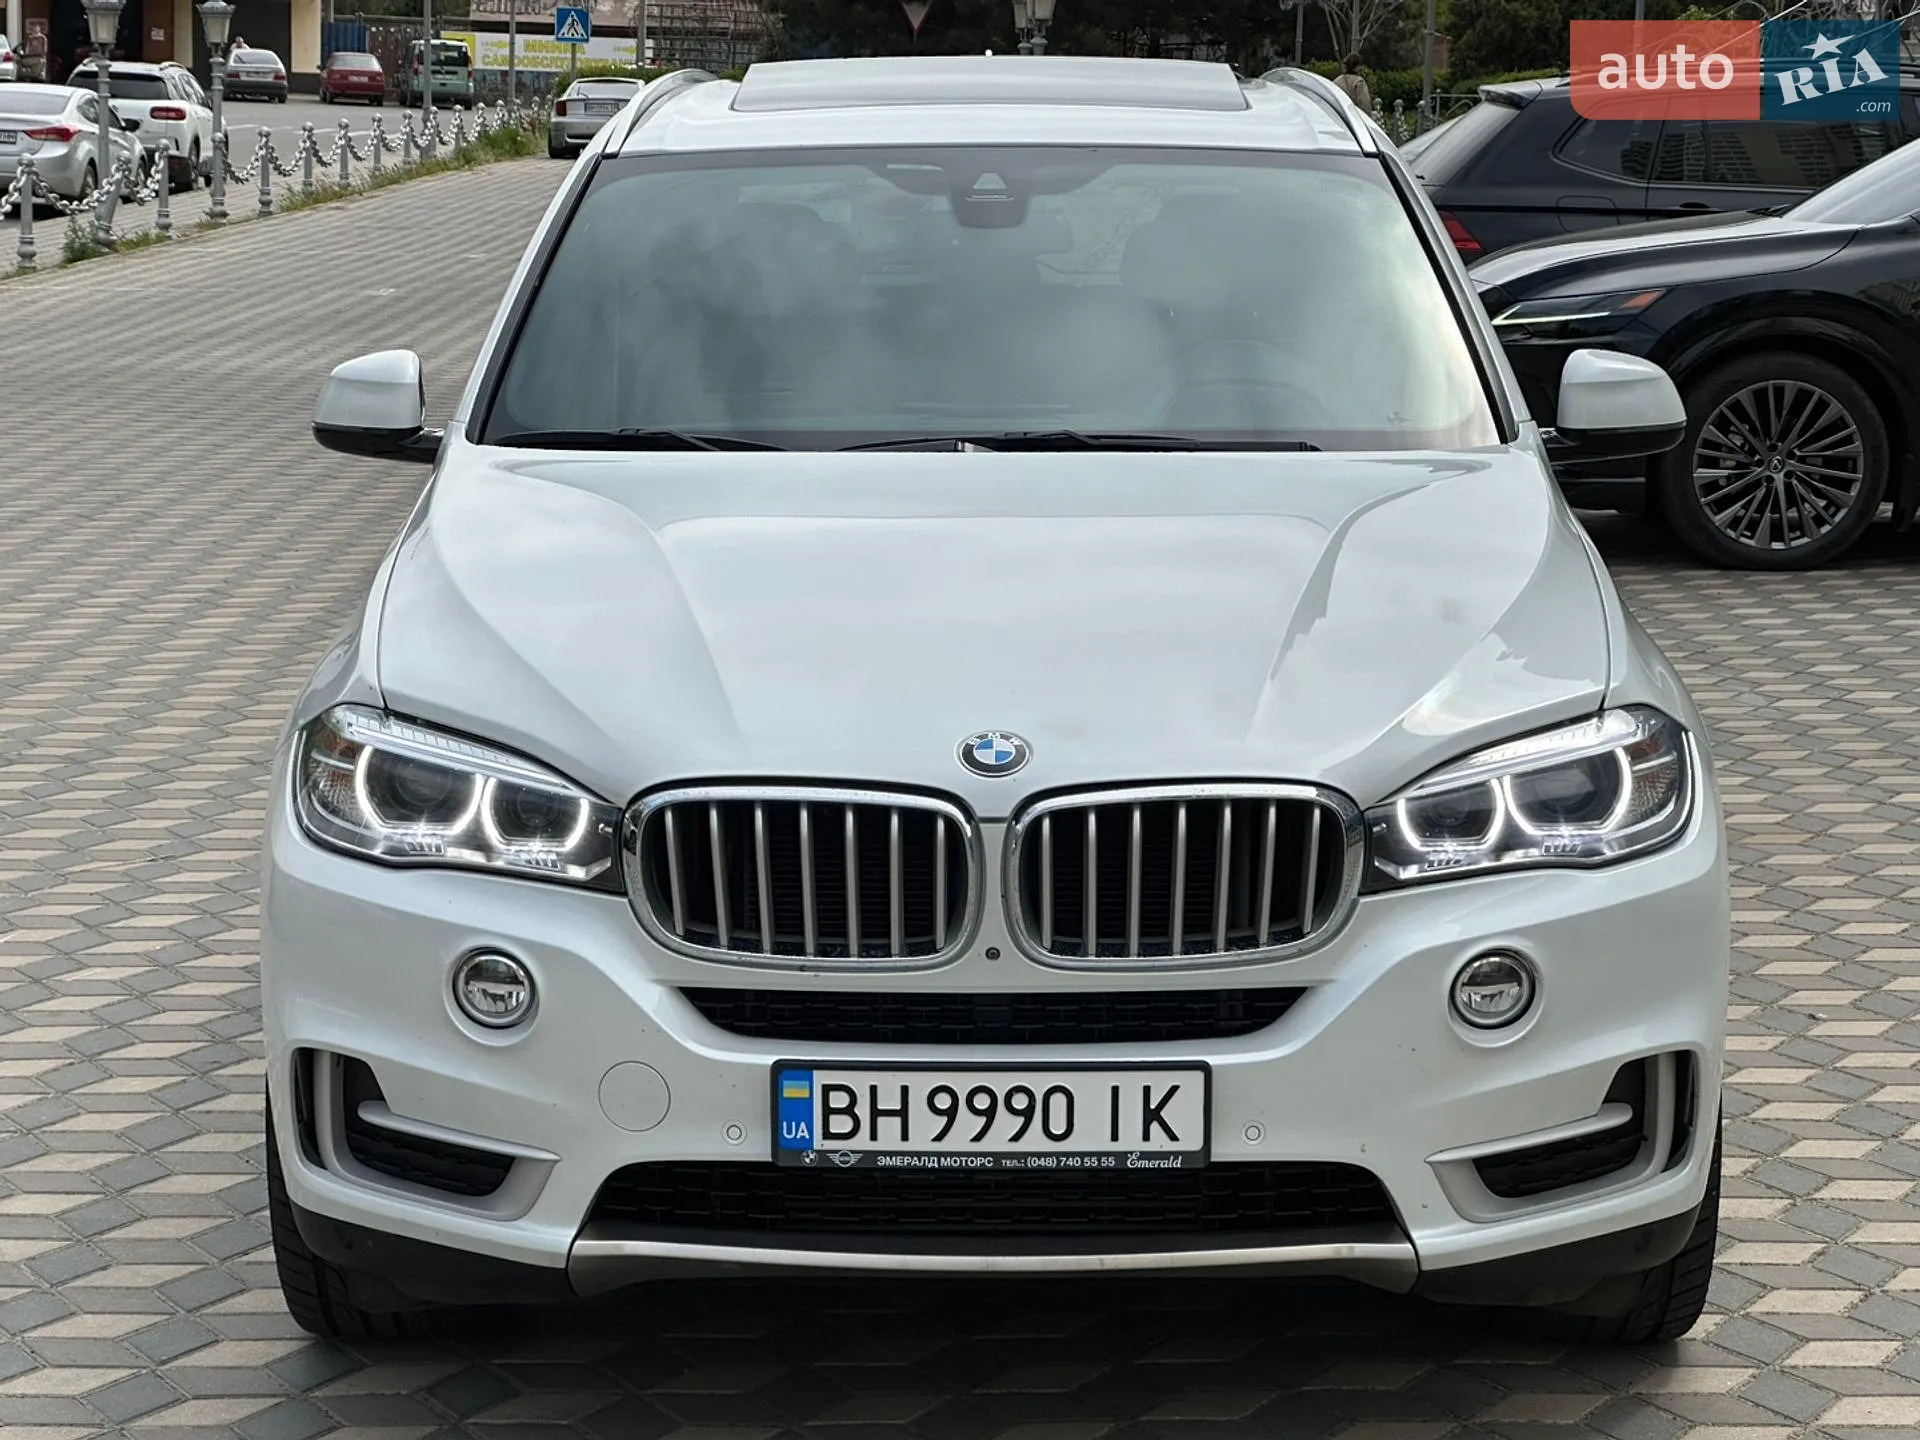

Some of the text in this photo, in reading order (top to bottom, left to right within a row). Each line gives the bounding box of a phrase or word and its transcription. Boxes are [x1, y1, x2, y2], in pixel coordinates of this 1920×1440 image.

[927, 1084, 1075, 1142] 9990
[783, 1121, 809, 1139] UA
[876, 1156, 938, 1167] ЭМЕРАЛД
[940, 1156, 994, 1167] МОТОРС
[1027, 1156, 1057, 1168] (048)
[1060, 1157, 1081, 1167] 740
[1083, 1157, 1098, 1167] 55
[1100, 1156, 1115, 1167] 55
[1126, 1151, 1182, 1169] Emerald
